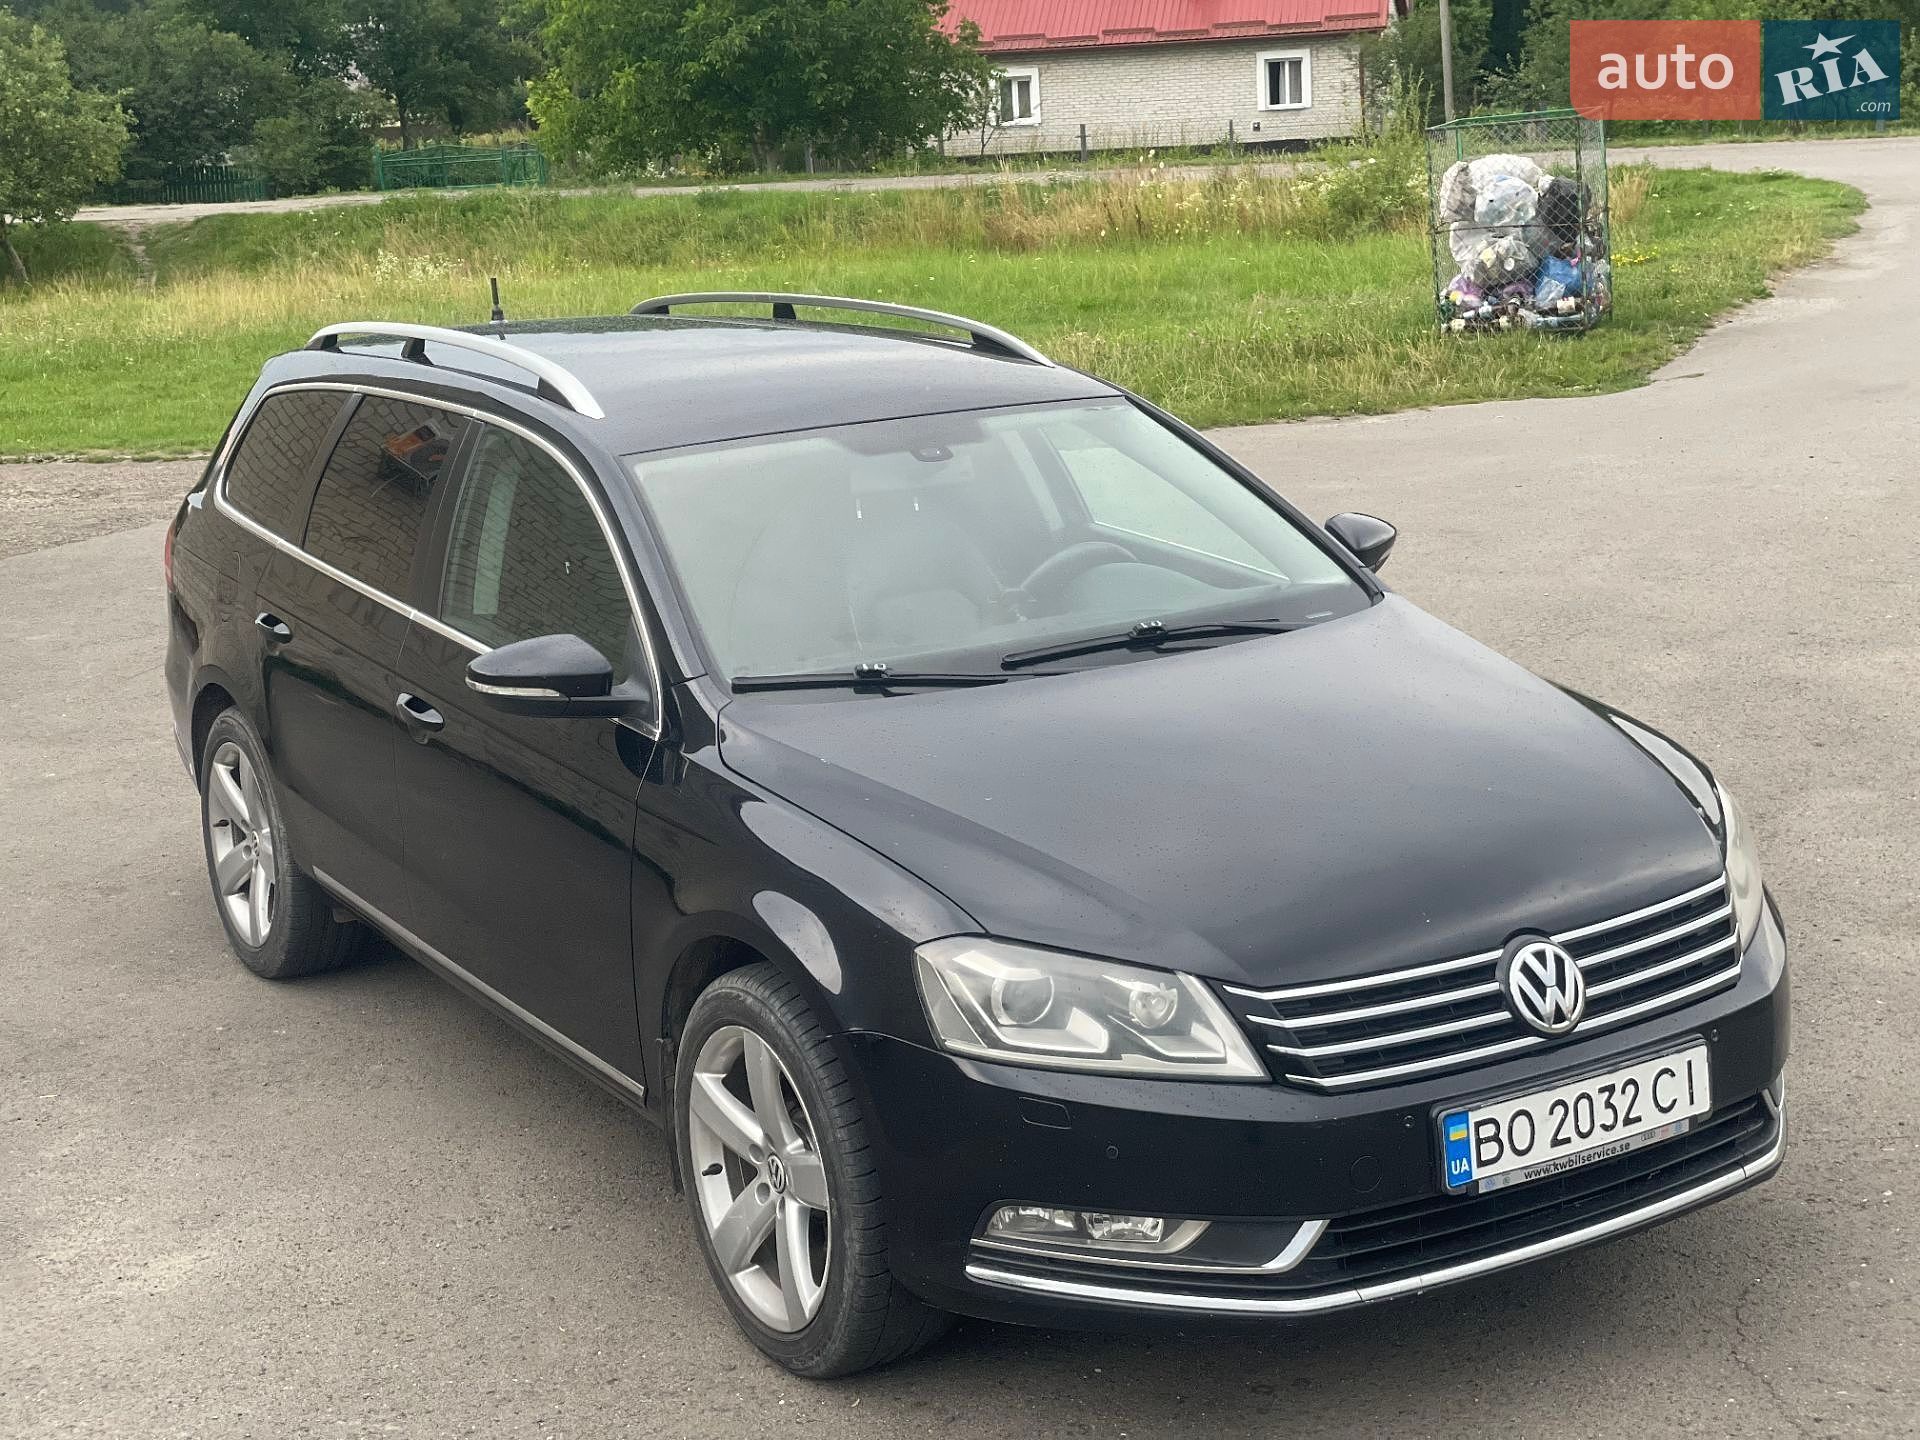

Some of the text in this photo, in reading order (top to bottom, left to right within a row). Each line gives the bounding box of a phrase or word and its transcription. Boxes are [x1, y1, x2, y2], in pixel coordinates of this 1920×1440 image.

[1473, 1059, 1695, 1168] BO 2032 CI
[1451, 1159, 1470, 1174] UA
[1523, 1141, 1631, 1180] www.kwbilservice.se
